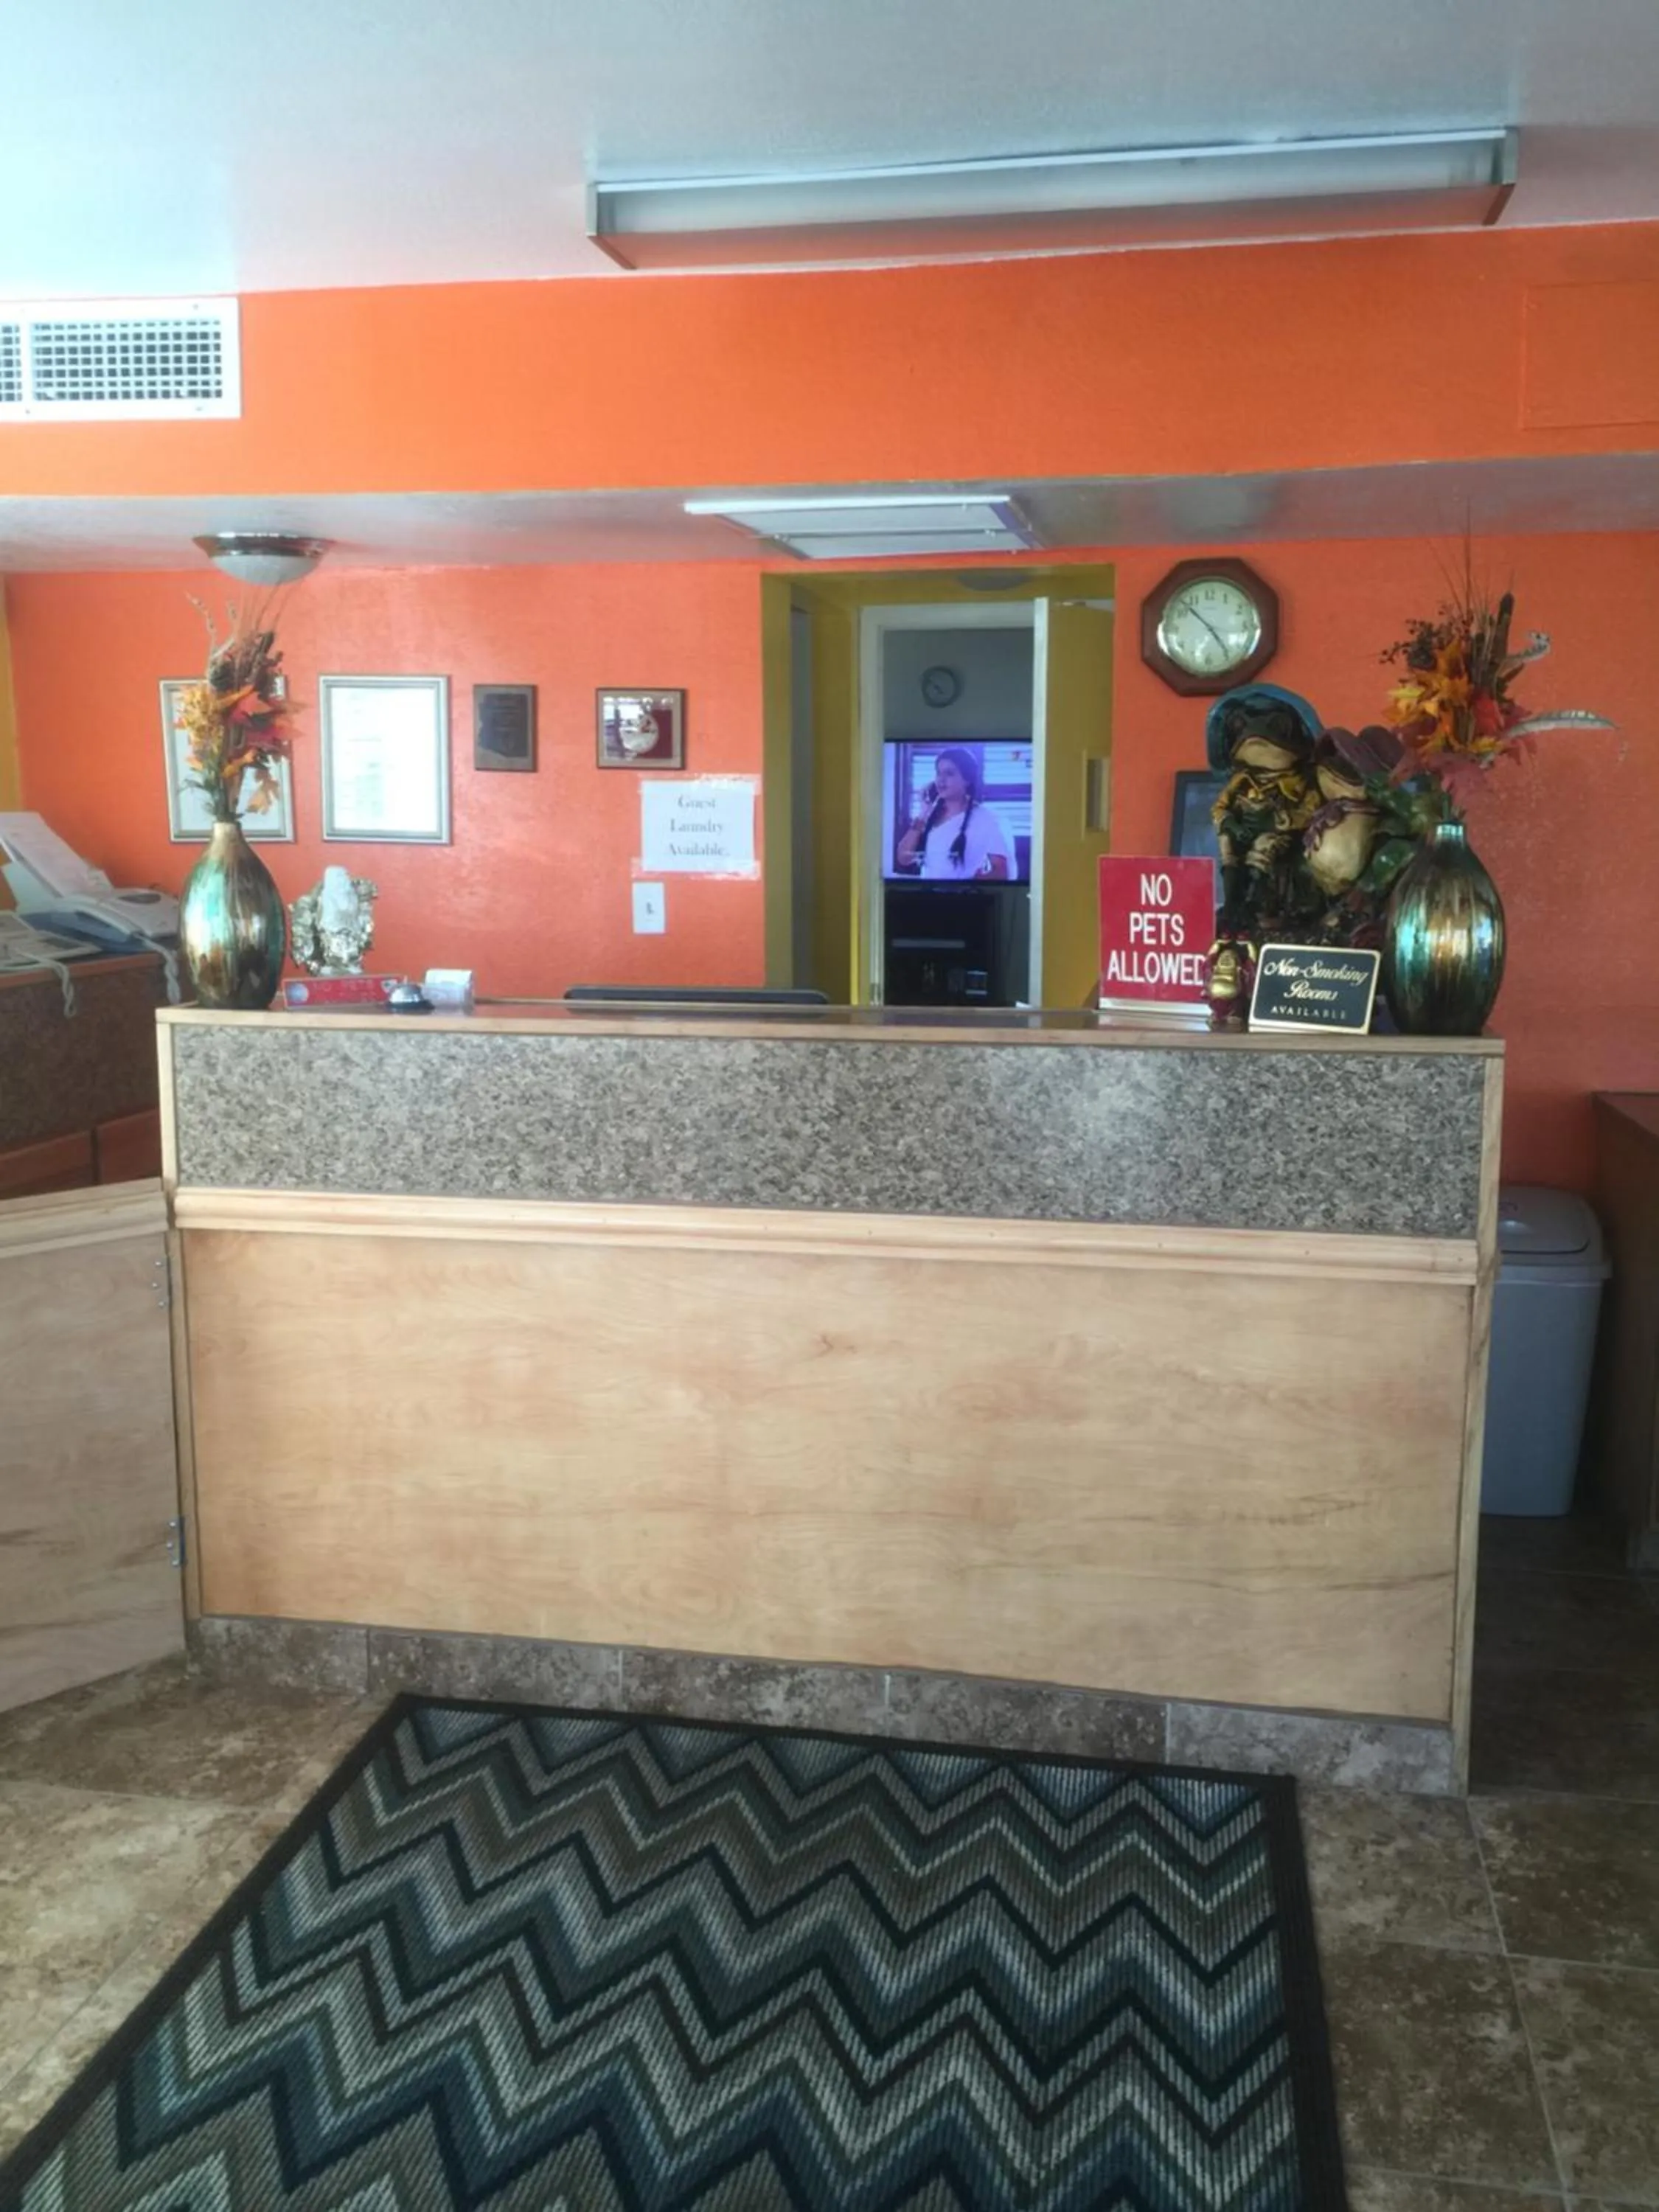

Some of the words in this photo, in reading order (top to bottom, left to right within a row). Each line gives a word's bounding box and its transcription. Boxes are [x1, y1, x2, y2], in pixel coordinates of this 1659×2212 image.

[678, 795, 717, 809] Guest
[670, 818, 723, 835] Laundry
[1141, 874, 1172, 906] NO
[1130, 912, 1184, 946] PETS
[1263, 958, 1369, 987] Non-Smoking
[1283, 979, 1338, 1001] Rooms
[1270, 1005, 1346, 1020] AVAILABLE
